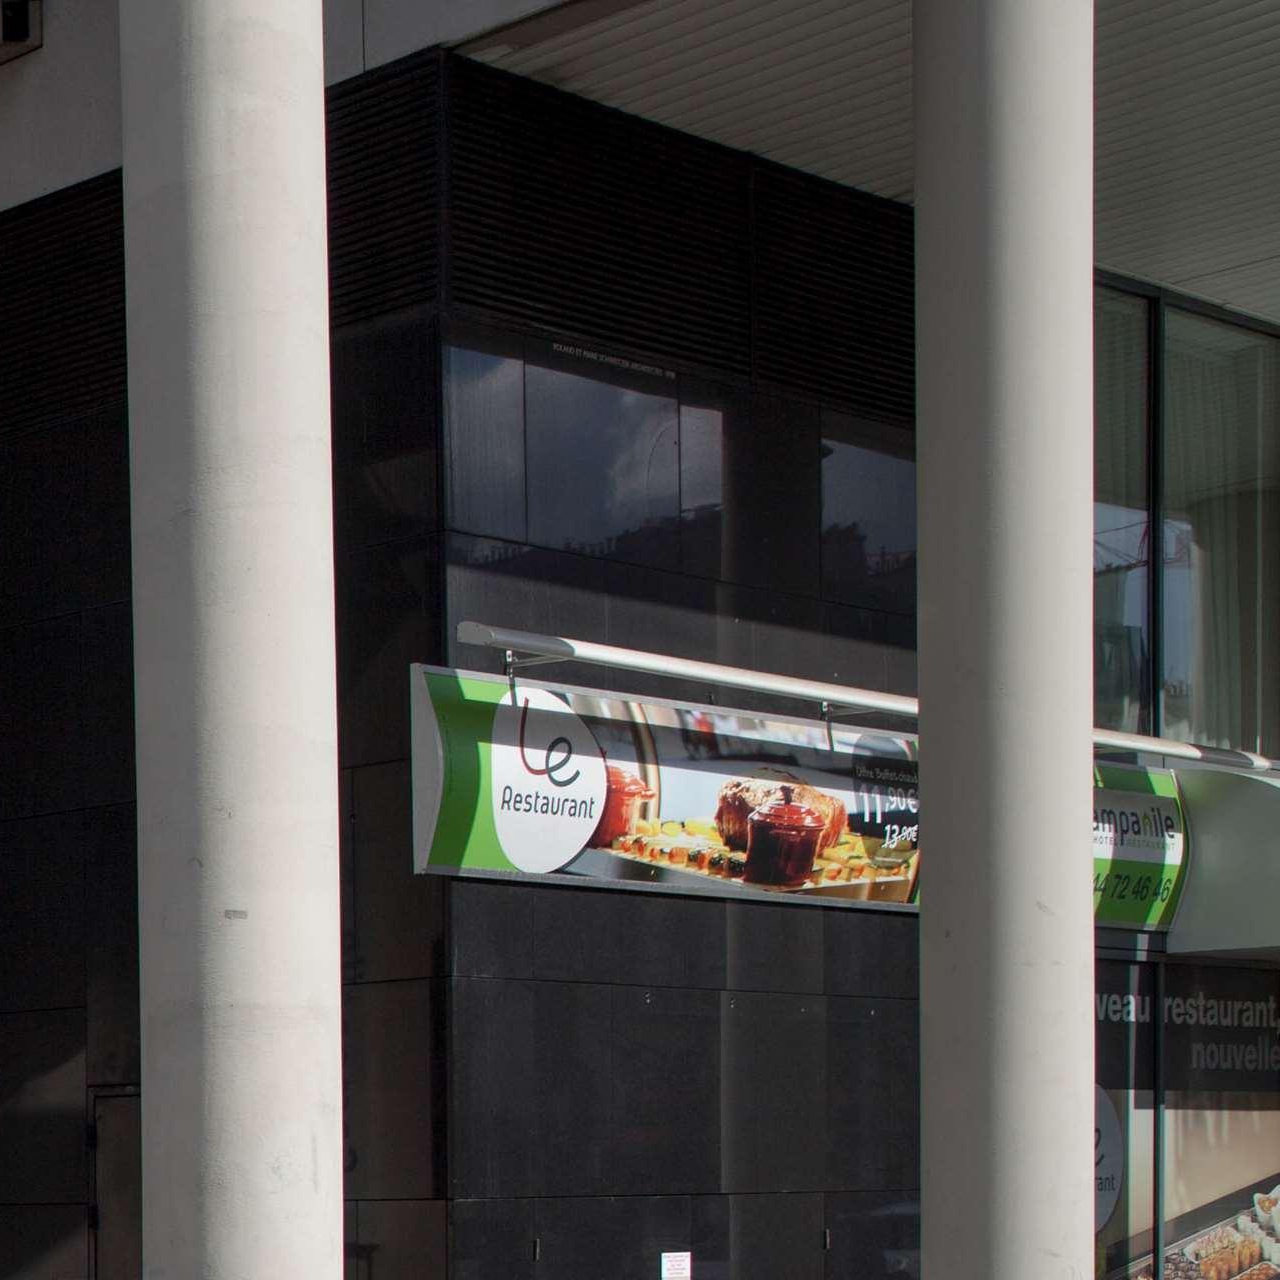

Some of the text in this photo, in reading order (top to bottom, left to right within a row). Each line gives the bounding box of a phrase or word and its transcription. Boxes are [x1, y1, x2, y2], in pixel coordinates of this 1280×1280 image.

[500, 785, 596, 819] Restaurant
[1093, 807, 1176, 846] ampanile
[1112, 874, 1131, 899] 72
[1131, 875, 1152, 900] 46
[1153, 877, 1173, 903] 46
[1095, 991, 1280, 1041] veau restaurant,
[1192, 1036, 1280, 1071] nouvelle
